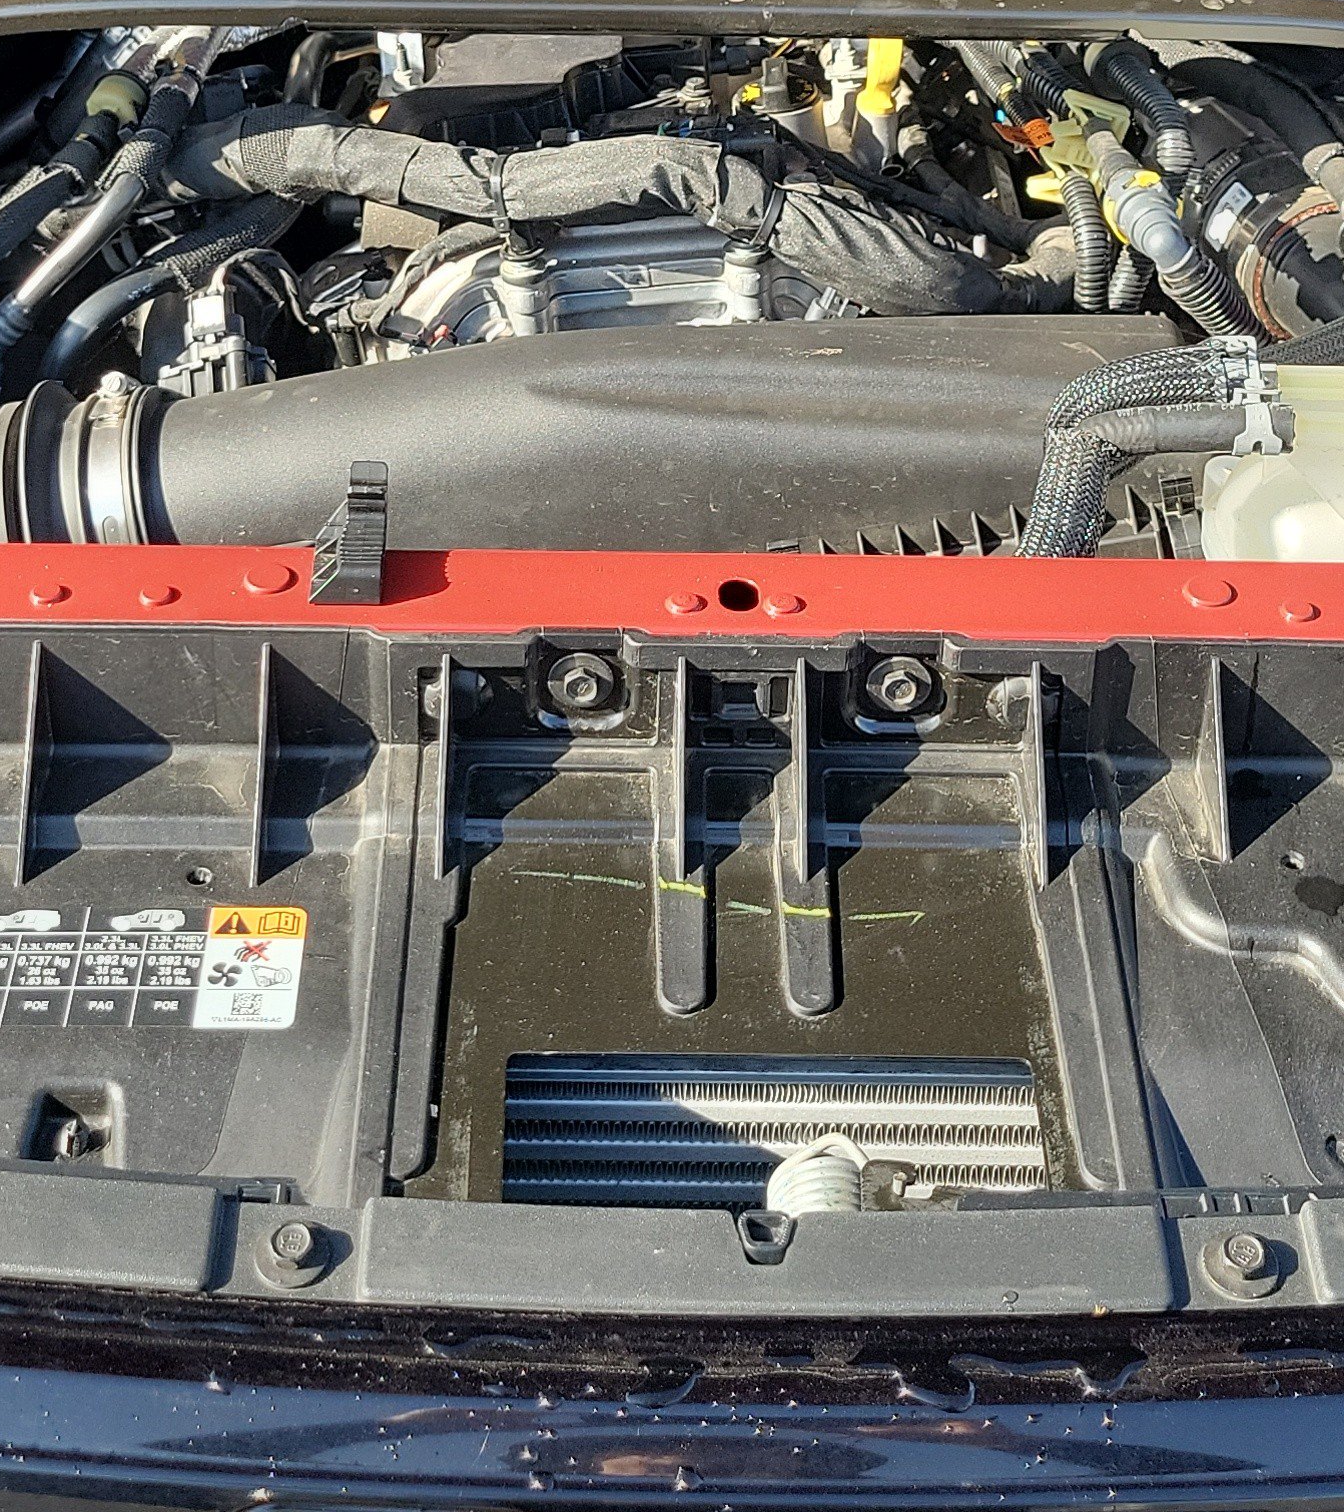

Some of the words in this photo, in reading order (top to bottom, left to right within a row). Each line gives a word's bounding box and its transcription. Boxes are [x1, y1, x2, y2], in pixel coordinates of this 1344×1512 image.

[53, 955, 71, 968] kg
[121, 954, 138, 968] kg
[183, 955, 201, 968] kg
[42, 968, 57, 976] oz
[110, 967, 124, 975] oz
[173, 967, 187, 975] oz
[43, 976, 61, 985] lbs
[111, 975, 129, 985] lbs
[174, 975, 192, 985] lbs
[23, 1000, 50, 1011] POE
[88, 1000, 114, 1011] PAG
[153, 1000, 180, 1011] POE
